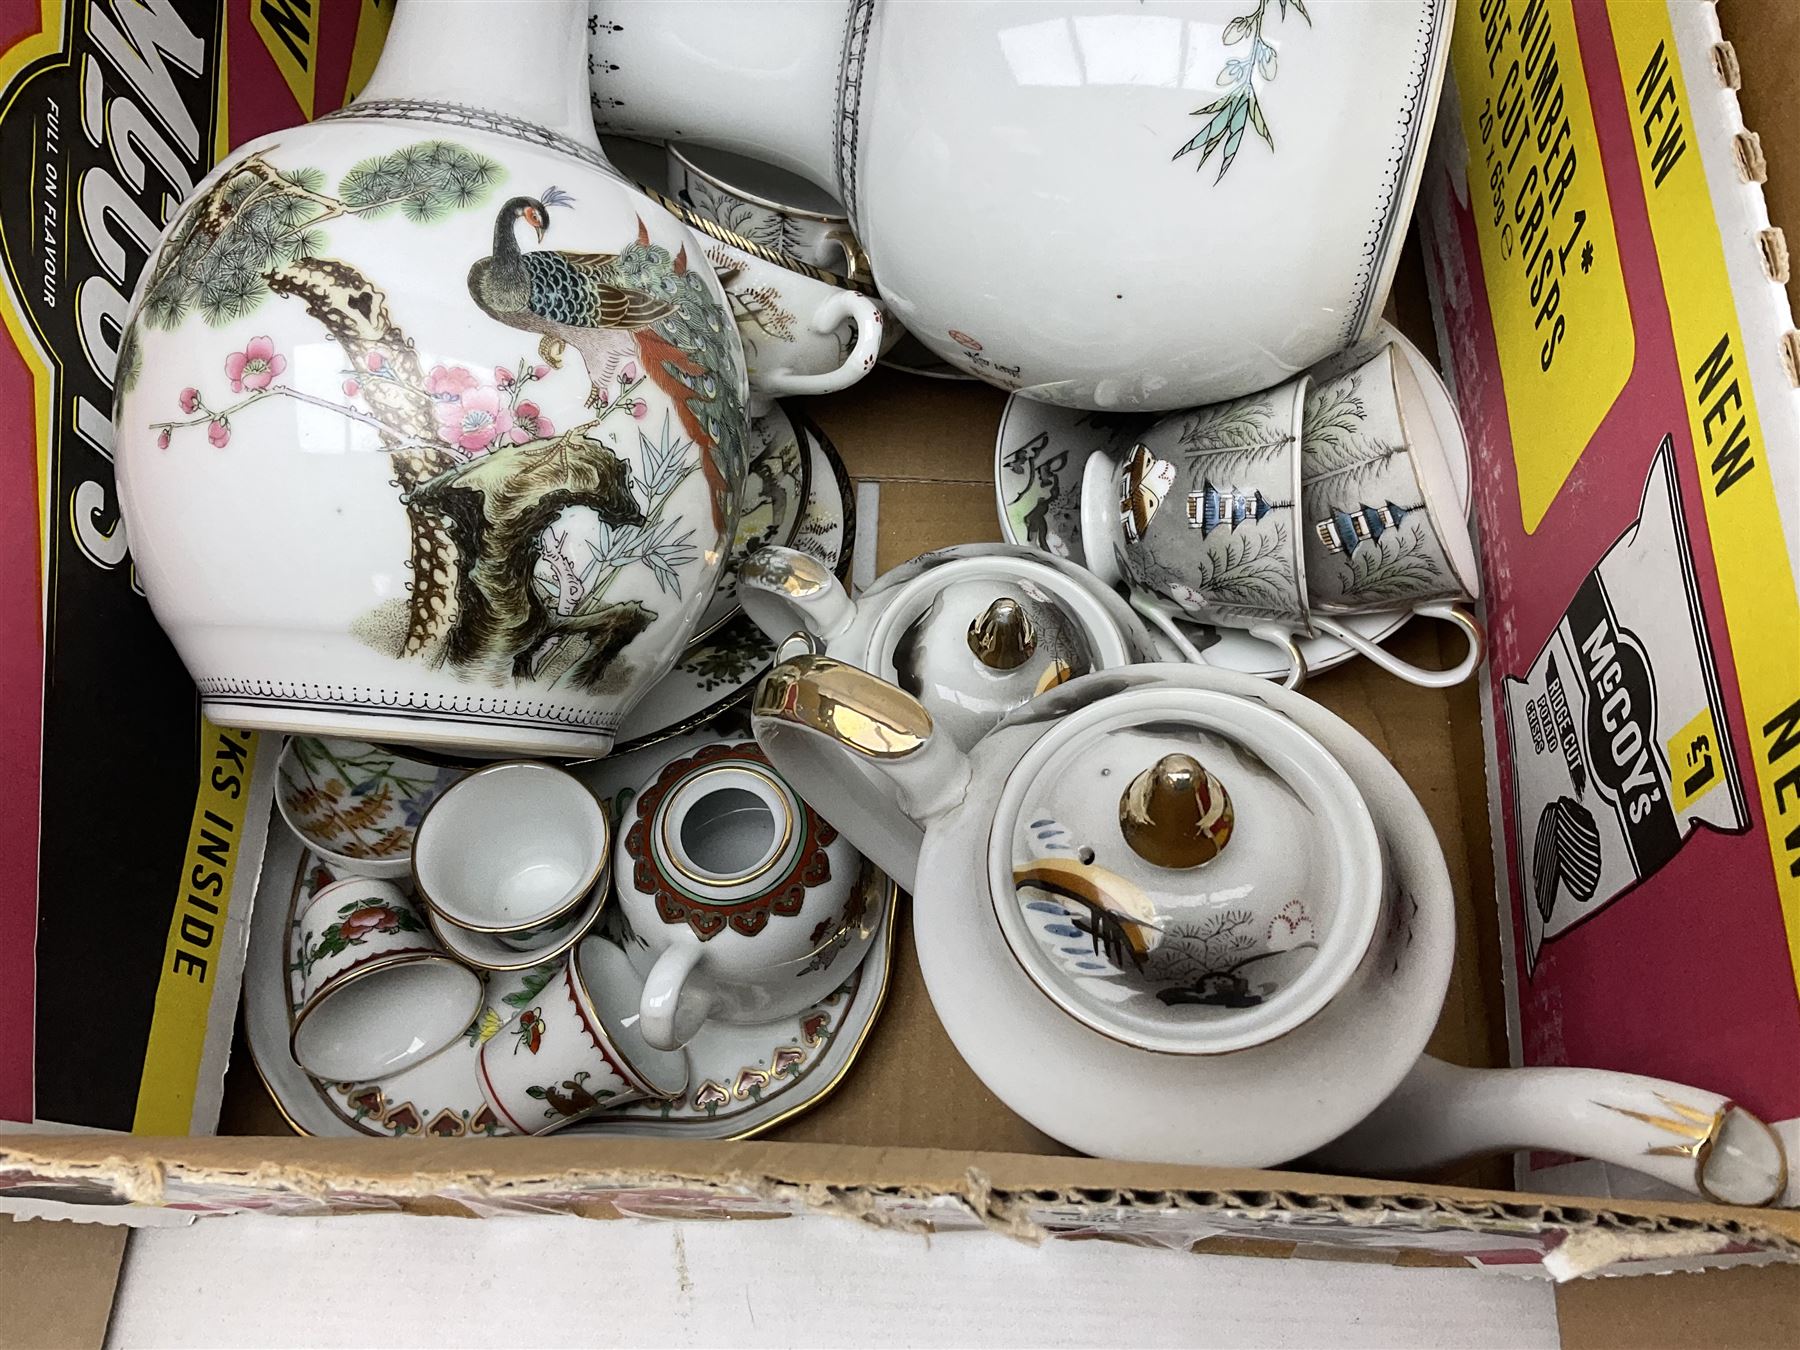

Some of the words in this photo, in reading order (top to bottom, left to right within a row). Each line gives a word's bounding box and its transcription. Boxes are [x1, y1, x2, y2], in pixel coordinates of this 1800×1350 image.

[45, 97, 59, 153] FULL
[1479, 98, 1493, 144] 20
[1490, 160, 1505, 227] 65g
[1518, 0, 1577, 218] NUMBER
[1635, 38, 1687, 190] NEW
[45, 162, 58, 198] ON
[1497, 60, 1531, 174] CUT
[1515, 165, 1566, 372] CRISPS
[43, 200, 57, 308] FLAVOUR
[1694, 332, 1755, 498] NEW
[1527, 701, 1544, 754] CRISPS
[1537, 695, 1557, 752] POTATO
[1548, 677, 1571, 734] RIDGE
[1563, 733, 1582, 770] CUT
[1683, 734, 1715, 798] £1
[173, 809, 234, 983] INSIDE
